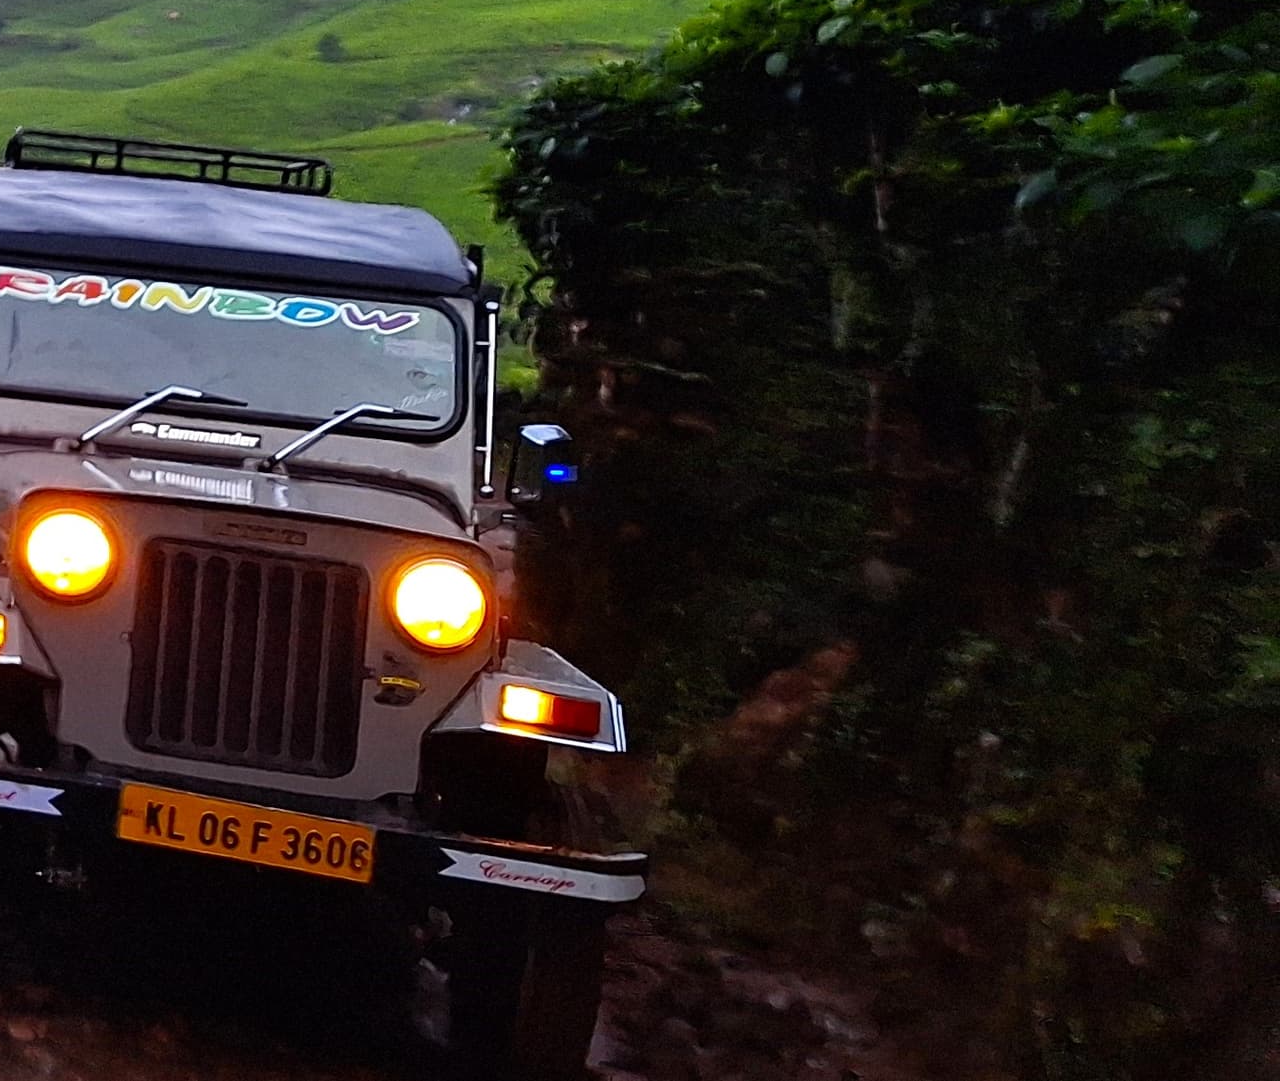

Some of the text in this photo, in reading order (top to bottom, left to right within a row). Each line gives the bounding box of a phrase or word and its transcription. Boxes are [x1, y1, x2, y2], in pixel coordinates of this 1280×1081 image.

[157, 424, 260, 448] Commander
[145, 801, 370, 871] KL 06 F 3606
